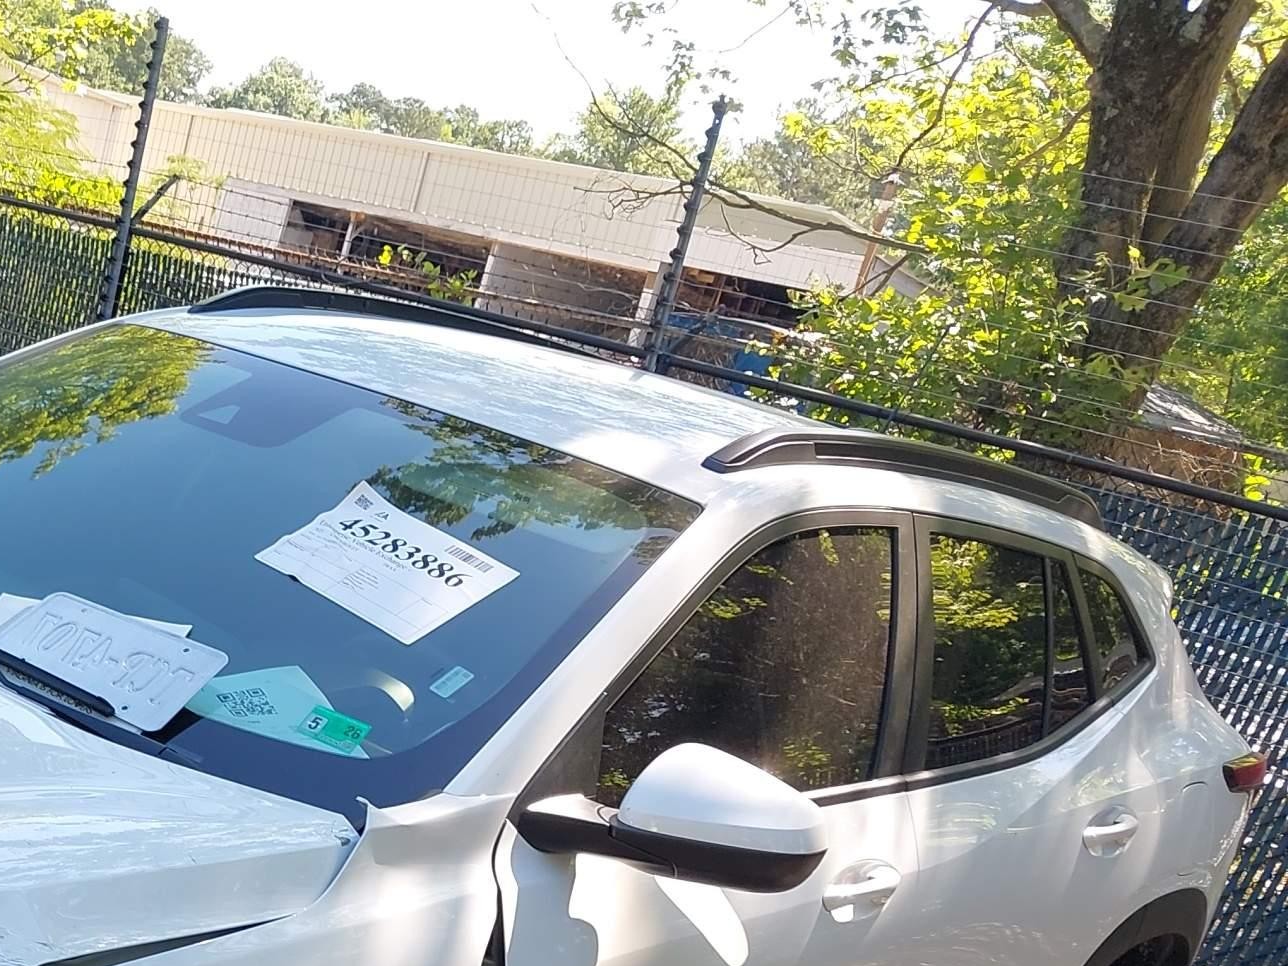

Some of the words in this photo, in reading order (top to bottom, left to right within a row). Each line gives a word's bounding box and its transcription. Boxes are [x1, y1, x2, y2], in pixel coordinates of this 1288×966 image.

[338, 518, 473, 588] 45283886
[307, 716, 324, 731] 5
[343, 725, 363, 740] 26
